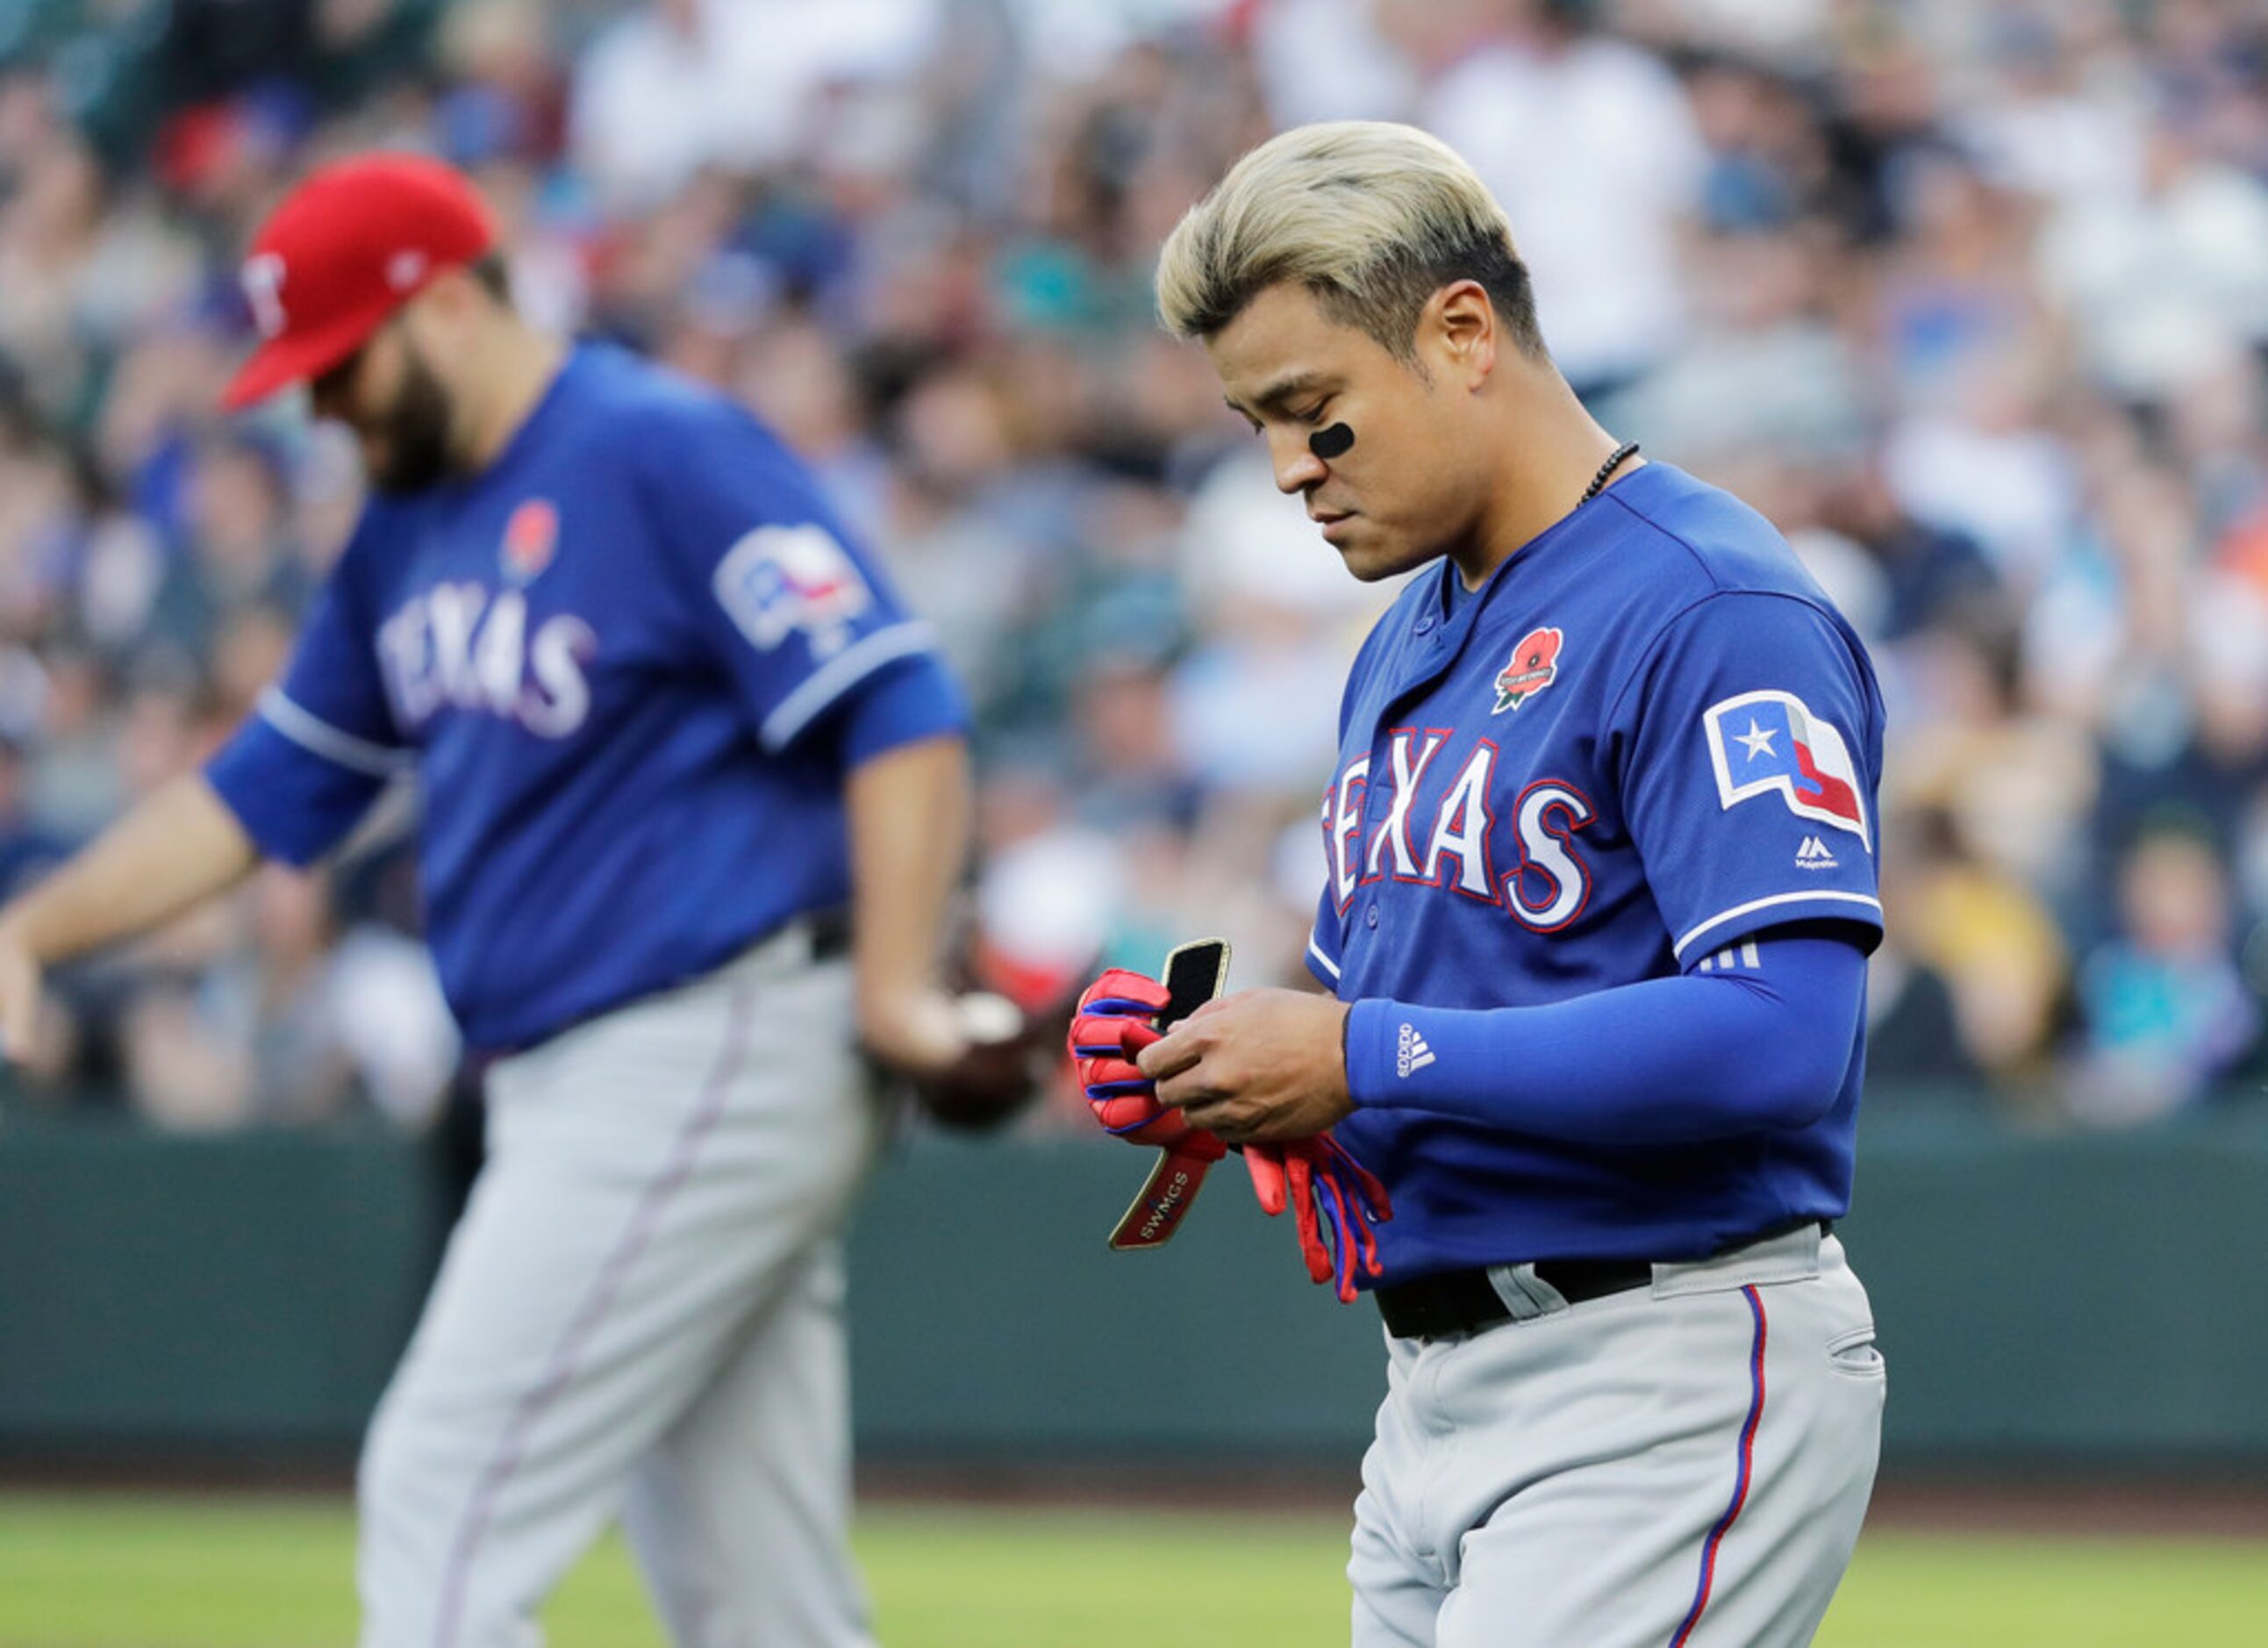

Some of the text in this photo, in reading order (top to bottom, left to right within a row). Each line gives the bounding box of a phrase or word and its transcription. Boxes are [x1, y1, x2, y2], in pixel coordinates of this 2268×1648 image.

[1321, 727, 1596, 934] EXAS
[1397, 1023, 1413, 1078] adidas
[1140, 1172, 1188, 1239] SWMGS
